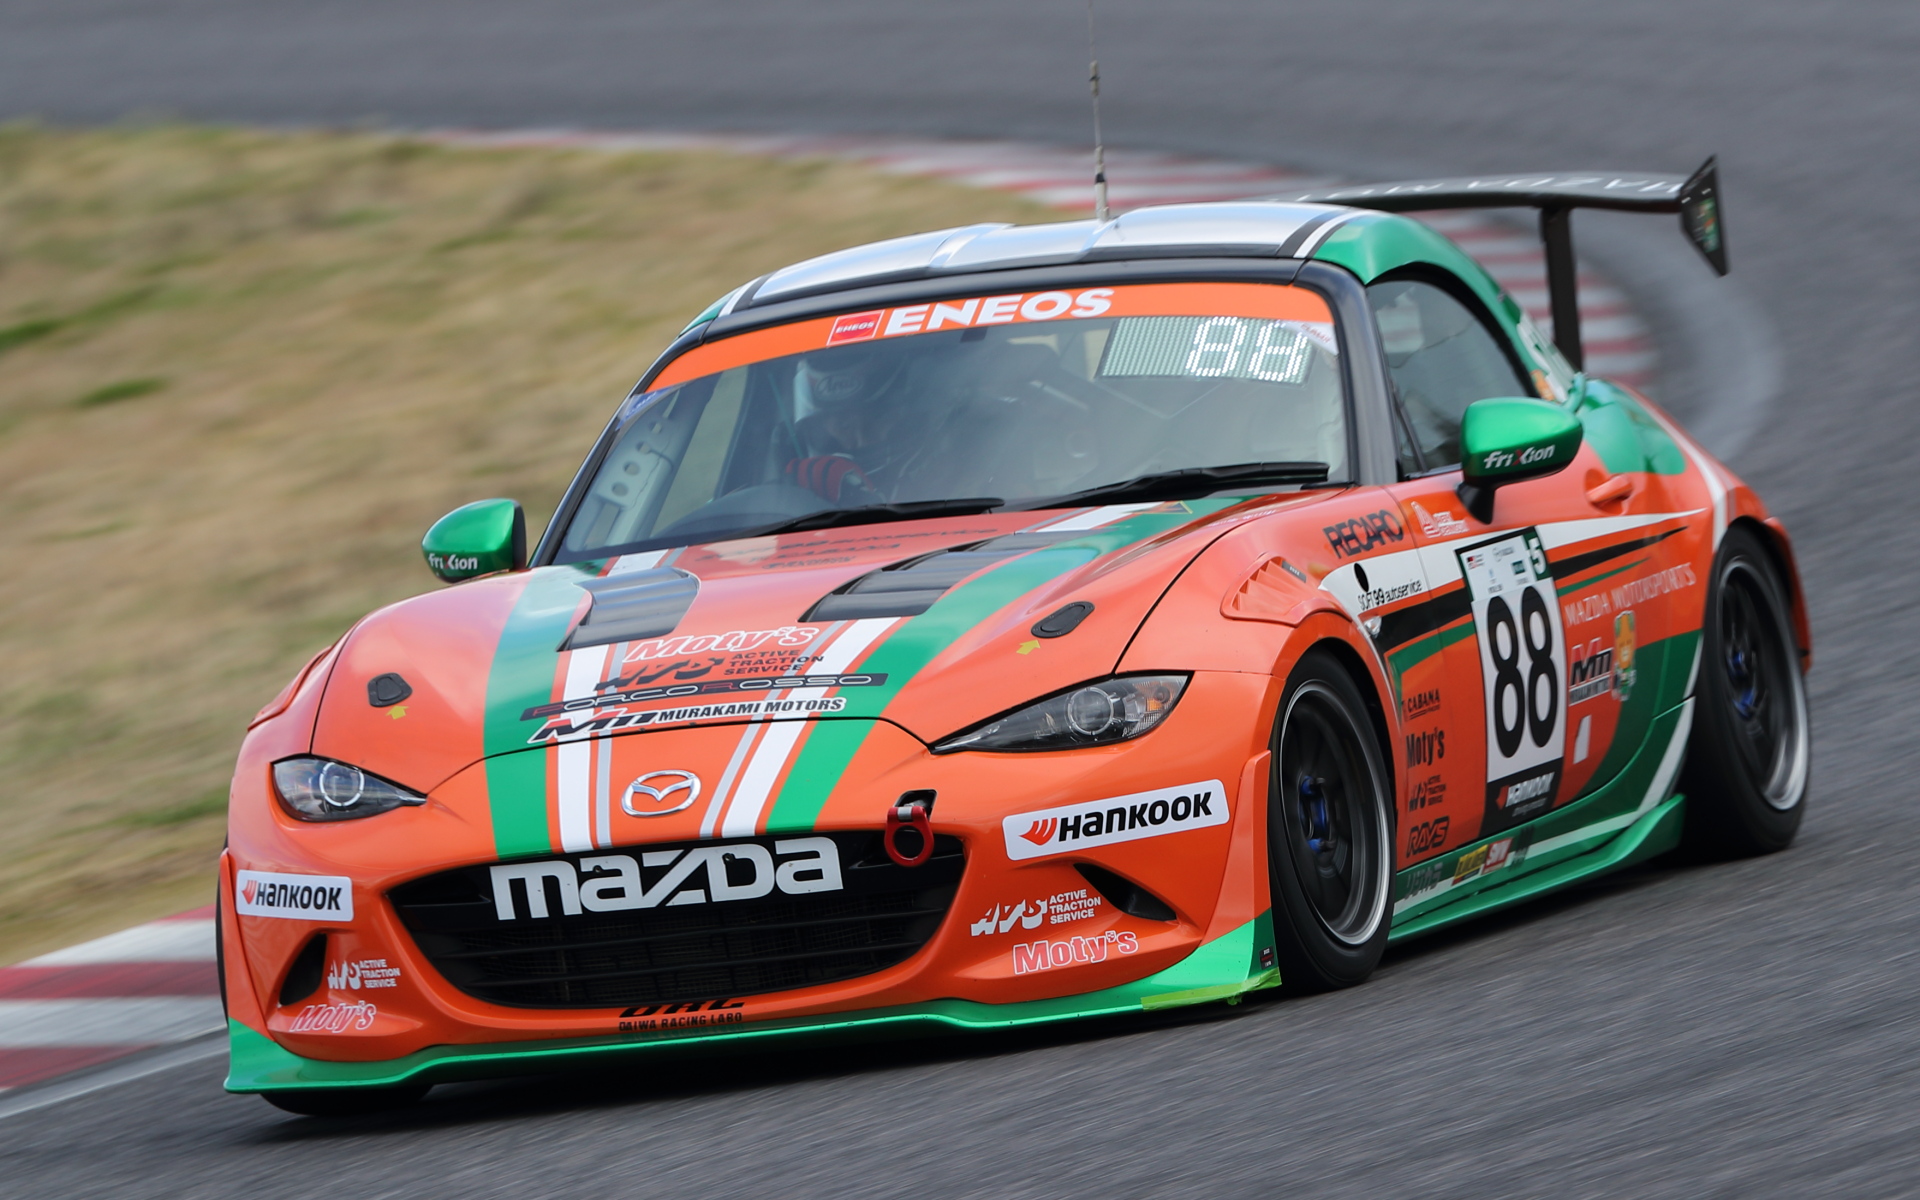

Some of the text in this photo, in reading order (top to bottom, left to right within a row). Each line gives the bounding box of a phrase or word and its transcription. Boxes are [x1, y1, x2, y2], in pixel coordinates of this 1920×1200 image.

[884, 288, 1115, 336] ENEOS
[836, 320, 875, 334] ENEOS
[1185, 316, 1308, 382] 88
[1323, 509, 1404, 559] RECARO
[1528, 537, 1546, 575] 5
[622, 626, 820, 663] Moty's
[731, 650, 799, 660] ACTIVE
[723, 664, 804, 676] SERVICE
[729, 655, 825, 667] TRACTION
[1487, 585, 1558, 758] 88
[658, 703, 760, 722] MURAKAMI
[764, 699, 844, 713] MOTORS
[1407, 688, 1440, 713] CABANA
[1406, 727, 1445, 769] Moty's
[1058, 791, 1213, 842] HANKOOK
[1406, 816, 1450, 859] RAYS
[255, 882, 342, 911] HANKOOK
[1049, 889, 1087, 904] ACTIVE
[1049, 897, 1101, 914] TRACTION
[1050, 909, 1095, 925] SERVICE
[359, 959, 387, 969] ACTIVE
[1012, 930, 1139, 975] Moty's
[361, 968, 401, 979] TRACTION
[364, 978, 397, 989] SERVICE
[289, 1001, 377, 1034] Moty's
[619, 1012, 742, 1031] DAIWA RACING LABO
